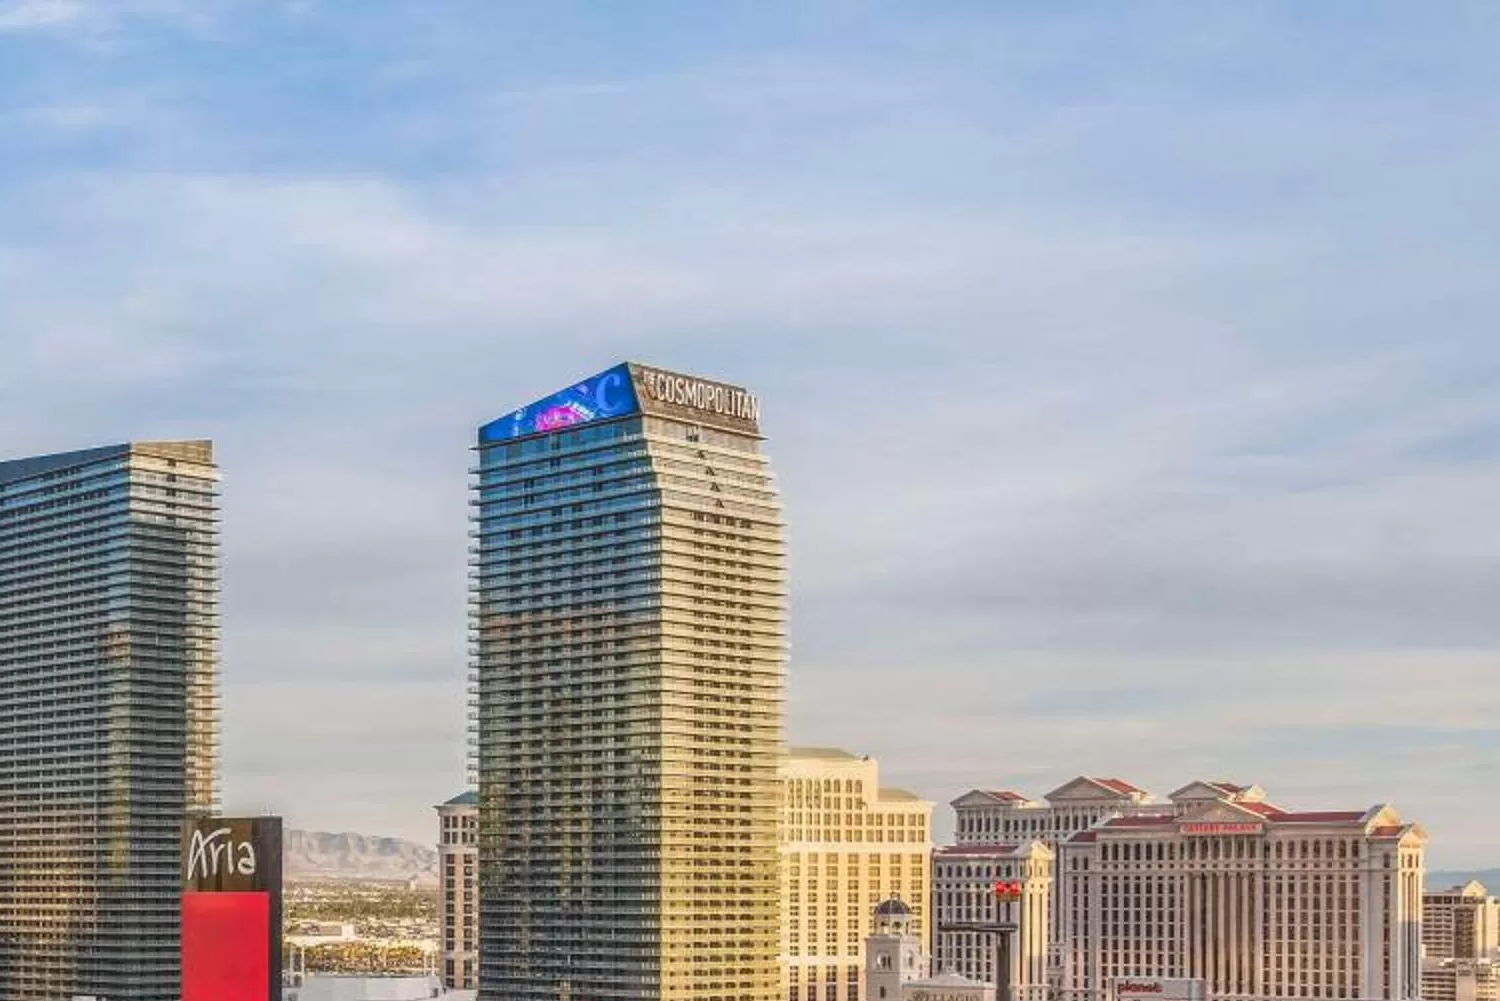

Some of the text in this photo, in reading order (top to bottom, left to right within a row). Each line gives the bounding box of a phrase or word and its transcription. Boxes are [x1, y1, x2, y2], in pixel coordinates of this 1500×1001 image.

[656, 374, 760, 422] COSMOPOLITAN
[187, 828, 256, 880] Aria
[1117, 981, 1163, 994] planet
